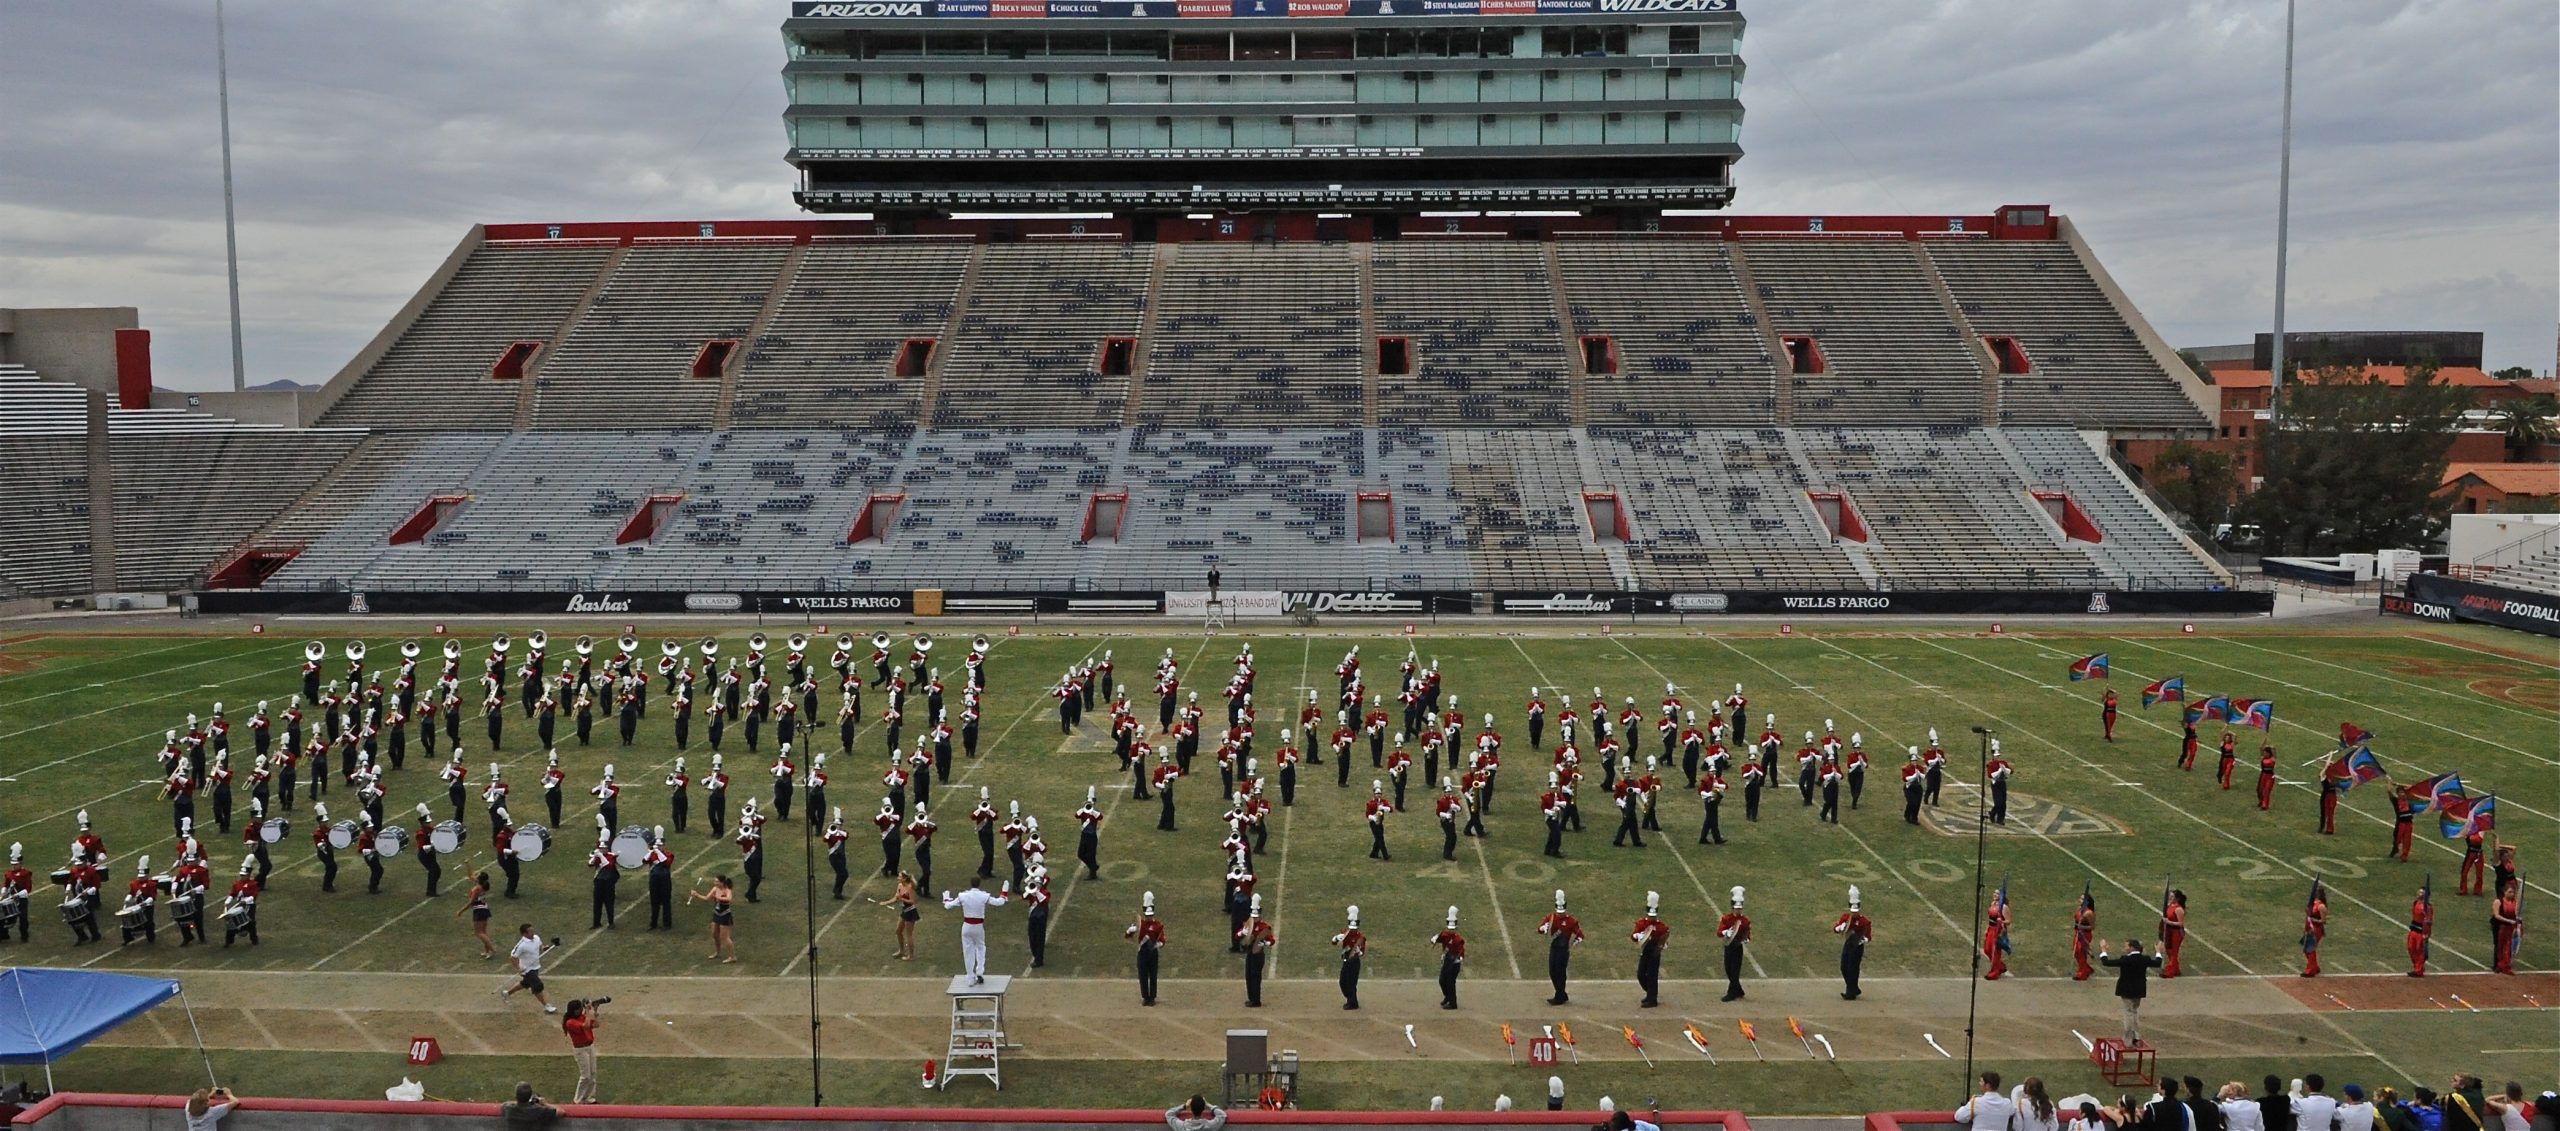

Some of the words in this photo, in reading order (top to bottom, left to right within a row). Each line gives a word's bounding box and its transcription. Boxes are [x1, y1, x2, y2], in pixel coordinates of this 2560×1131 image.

[938, 4, 946, 12] 22
[1481, 0, 1486, 8] 11
[1600, 0, 1727, 11] WILDCATS
[805, 3, 922, 16] ARIZONA
[701, 228, 713, 237] 18
[875, 227, 886, 236] 19
[1072, 225, 1085, 235] 20
[1221, 224, 1232, 234] 21
[1446, 223, 1459, 233] 22
[1646, 223, 1659, 232] 23
[1809, 223, 1822, 232] 24
[1950, 223, 1963, 232] 25
[549, 230, 559, 239] 17
[189, 396, 199, 406] 16
[566, 593, 632, 612] Bashas'
[796, 597, 848, 608] WELLS
[850, 597, 901, 608] FARGO
[1246, 599, 1264, 608] BAND
[1265, 599, 1278, 608] DAY
[1783, 597, 1836, 608] WELLS
[1838, 597, 1890, 608] FARGO
[2385, 598, 2413, 615] BEAR
[2413, 602, 2451, 620] DOWN
[2502, 600, 2560, 622] FOOTBALL
[1415, 858, 1556, 885] 40
[1817, 857, 1966, 884] 30
[2215, 855, 2369, 882] 20
[410, 1041, 429, 1061] 40
[976, 1042, 990, 1059] 50
[1533, 1042, 1552, 1062] 40
